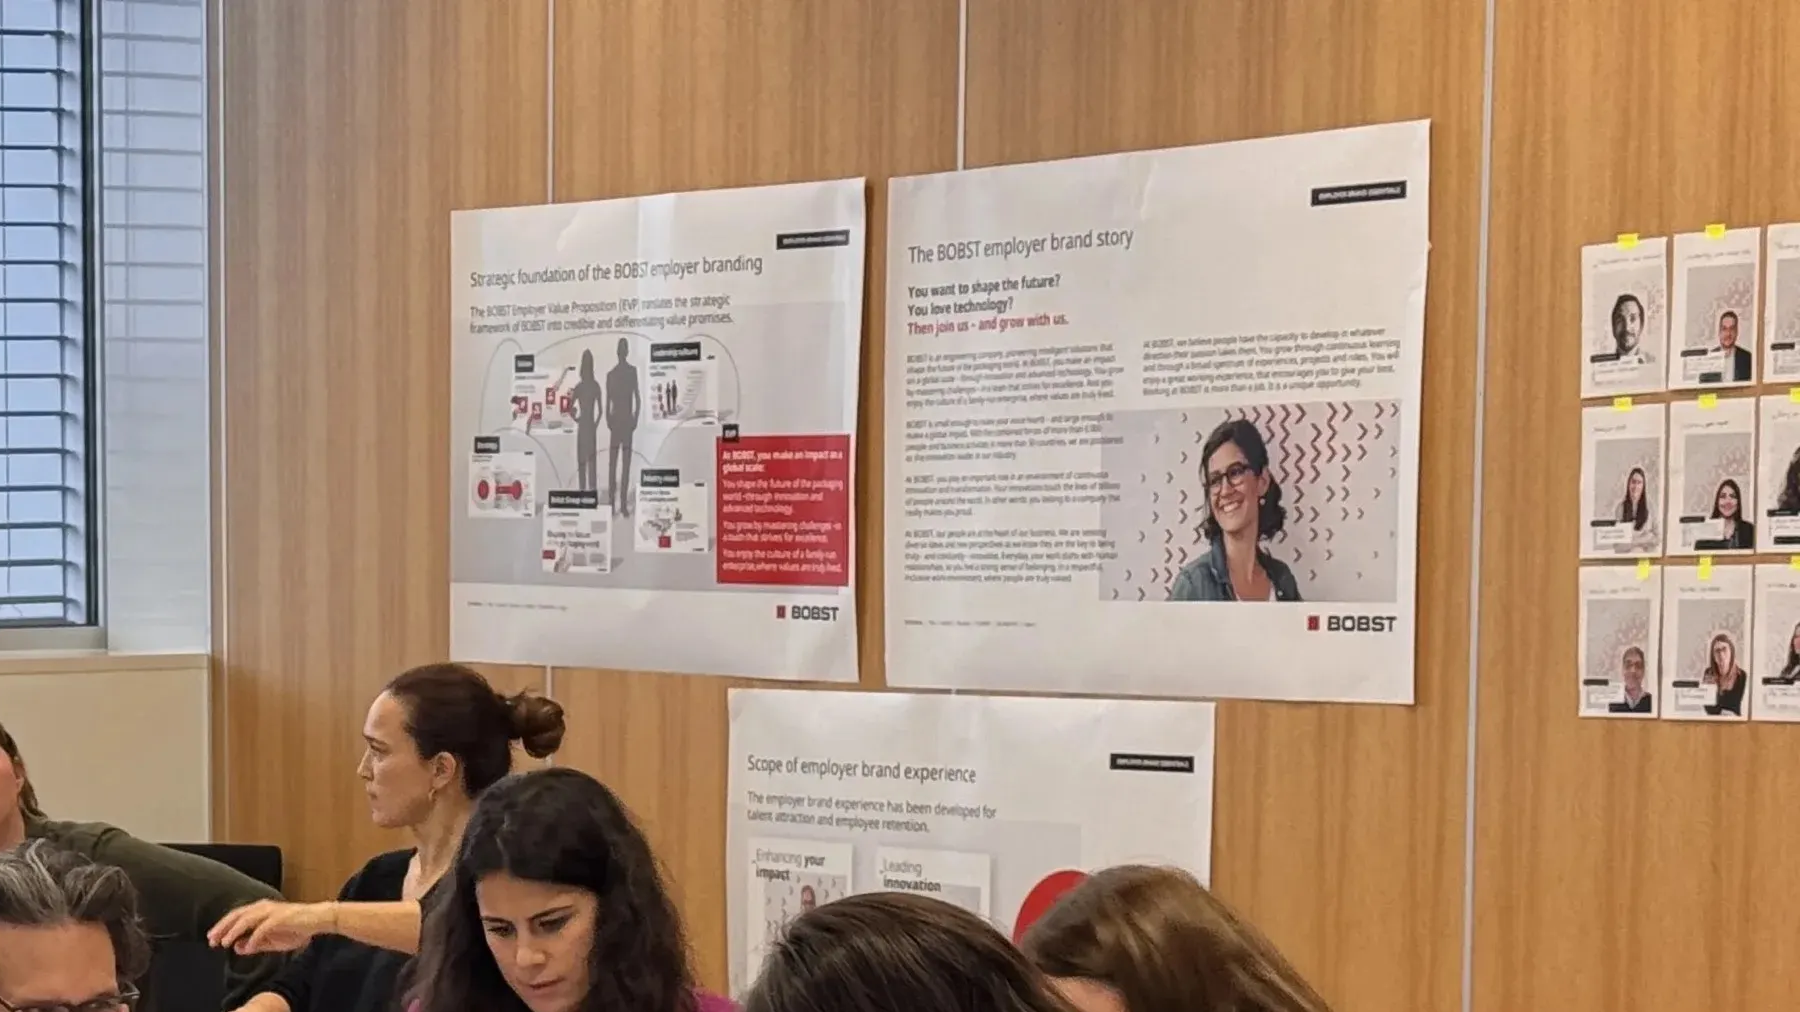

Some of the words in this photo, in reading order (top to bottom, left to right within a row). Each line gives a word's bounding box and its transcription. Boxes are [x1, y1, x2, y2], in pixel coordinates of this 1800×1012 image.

[908, 245, 934, 264] The
[937, 240, 981, 262] BOBST
[983, 236, 1047, 261] employer
[1050, 230, 1093, 251] brand
[1096, 229, 1134, 250] story
[470, 271, 515, 290] Strategic
[518, 266, 575, 284] foundation
[578, 264, 591, 282] of
[593, 263, 611, 281] the
[614, 261, 648, 279] BOBST
[650, 258, 700, 281] employer
[703, 255, 763, 275] branding
[908, 286, 928, 299] You
[930, 283, 956, 297] want
[958, 281, 969, 294] to
[971, 278, 1000, 296] shape
[1002, 277, 1019, 291] the
[1021, 273, 1061, 289] future?
[470, 306, 485, 318] The
[487, 304, 511, 317] BOBST
[690, 294, 731, 310] strategic
[908, 304, 928, 317] You
[930, 301, 951, 315] love
[953, 296, 1014, 314] technology?
[597, 316, 613, 329] and
[688, 312, 734, 328] promises.
[907, 322, 934, 336] Then
[935, 320, 955, 337] join
[957, 319, 969, 332] us
[978, 316, 998, 331] and
[999, 316, 1024, 333] grow
[1026, 313, 1051, 327] with
[1053, 312, 1069, 326] us.
[791, 605, 839, 621] BOBST
[1327, 615, 1397, 632] BOBST
[747, 754, 783, 777] Scope
[786, 756, 799, 774] of
[801, 758, 859, 781] employer
[861, 761, 901, 779] brand
[904, 766, 976, 785] experience
[747, 790, 765, 805] The
[766, 793, 805, 809] employer
[807, 795, 833, 809] brand
[835, 798, 885, 814] experience
[887, 800, 904, 813] has
[906, 800, 932, 815] been
[934, 802, 981, 820] developed
[982, 803, 997, 819] for
[747, 809, 773, 822] talent
[775, 811, 816, 824] attraction
[817, 813, 834, 826] and
[835, 816, 880, 832] employee
[882, 818, 930, 833] retention.
[756, 848, 802, 869] Enhancing
[804, 855, 825, 868] your
[883, 857, 922, 878] Leading
[756, 868, 790, 883] impact
[883, 874, 941, 892] innovation
